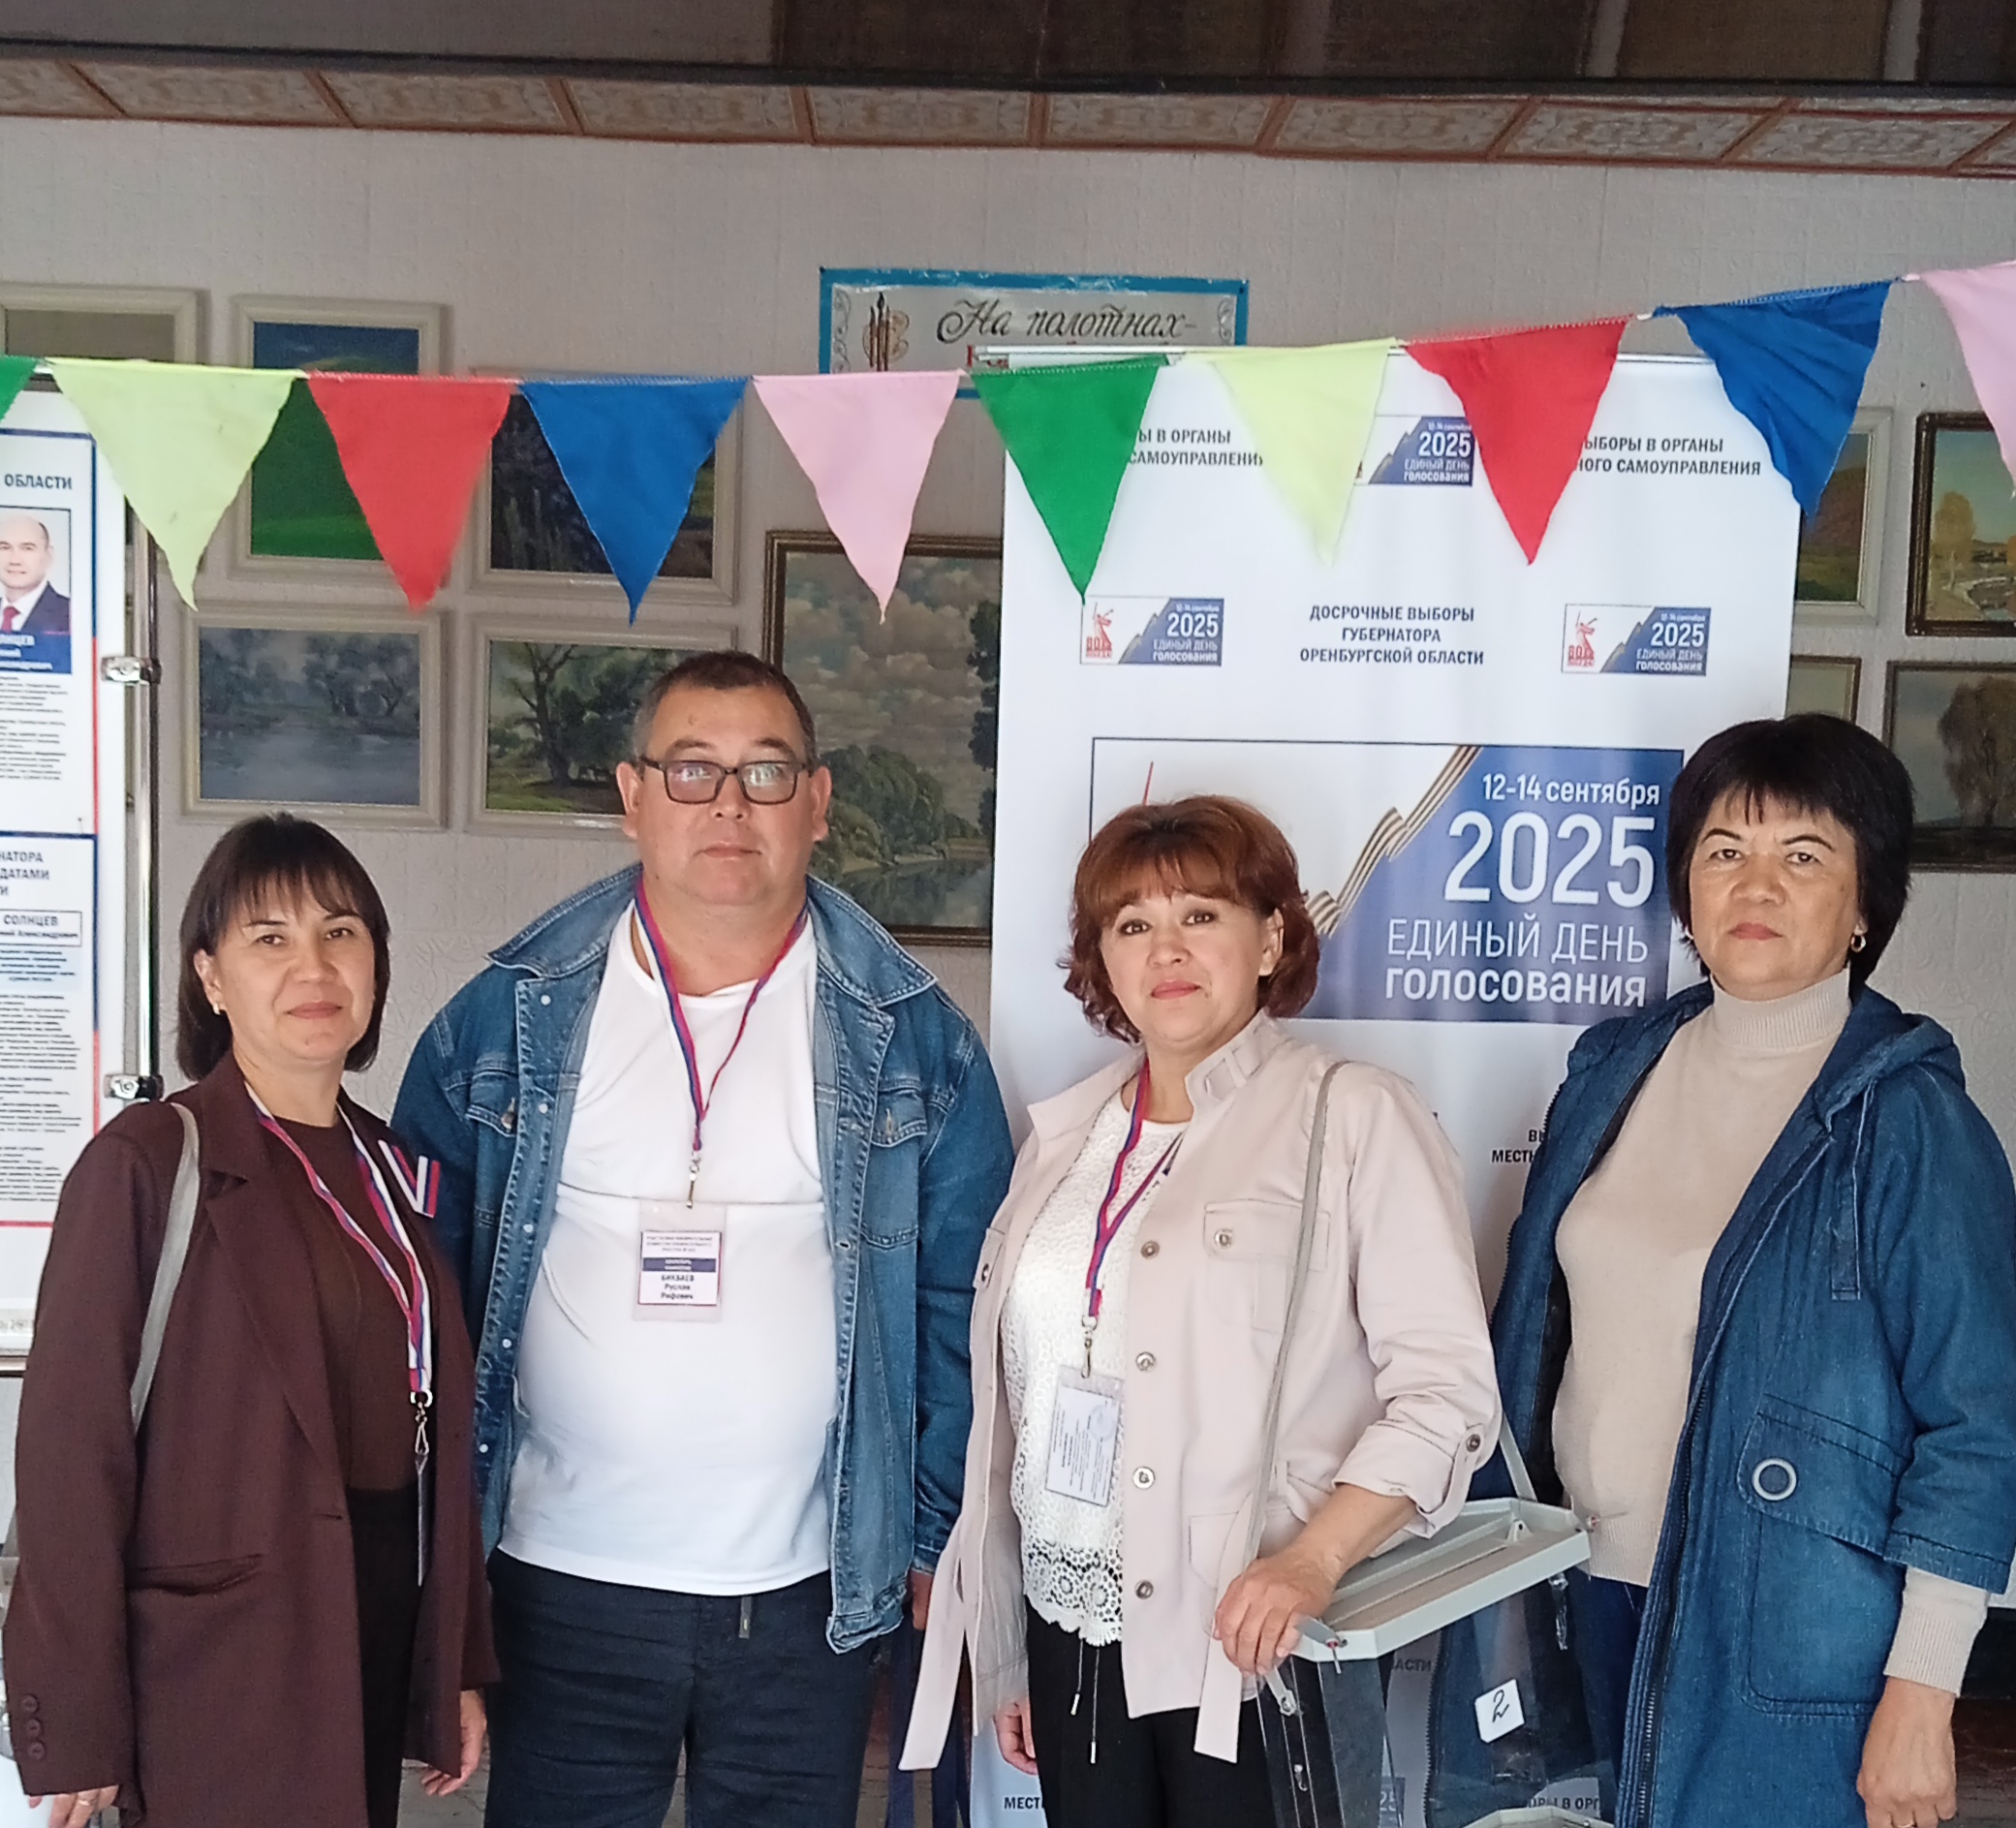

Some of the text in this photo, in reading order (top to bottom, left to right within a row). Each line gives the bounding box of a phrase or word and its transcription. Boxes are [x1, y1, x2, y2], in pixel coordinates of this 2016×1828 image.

[937, 298, 1011, 343] На
[1157, 429, 1166, 443] В
[1171, 429, 1231, 444] ОРГАНЫ
[1418, 431, 1472, 457] 2025
[1583, 436, 1723, 452] ЫБОРЫ В ОРГАНЫ
[1617, 459, 1761, 476] САМОУПРАВЛЕНИЯ
[4, 474, 73, 489] ОБЛАСТИ
[1166, 612, 1219, 637] 2025
[1310, 605, 1474, 622] ДОСРОЧНЫЕ ВЫБОРЫ
[1342, 627, 1441, 642] ГУБЕРНАТОРА
[1651, 622, 1704, 647] 2025
[1300, 646, 1484, 665] ОРЕНБУРГСКОЙ ОБЛАСТИ
[1483, 773, 1659, 810] 12-14 сентября
[1443, 810, 1656, 908] 2025
[4, 914, 58, 927] СОЛНЦЕВ
[1387, 913, 1648, 965] ЕДИНЫЙ ДЕНЬ
[1385, 968, 1646, 1007] голосования
[1493, 1689, 1509, 1722] 2
[1005, 1797, 1043, 1809] МЕСТ
